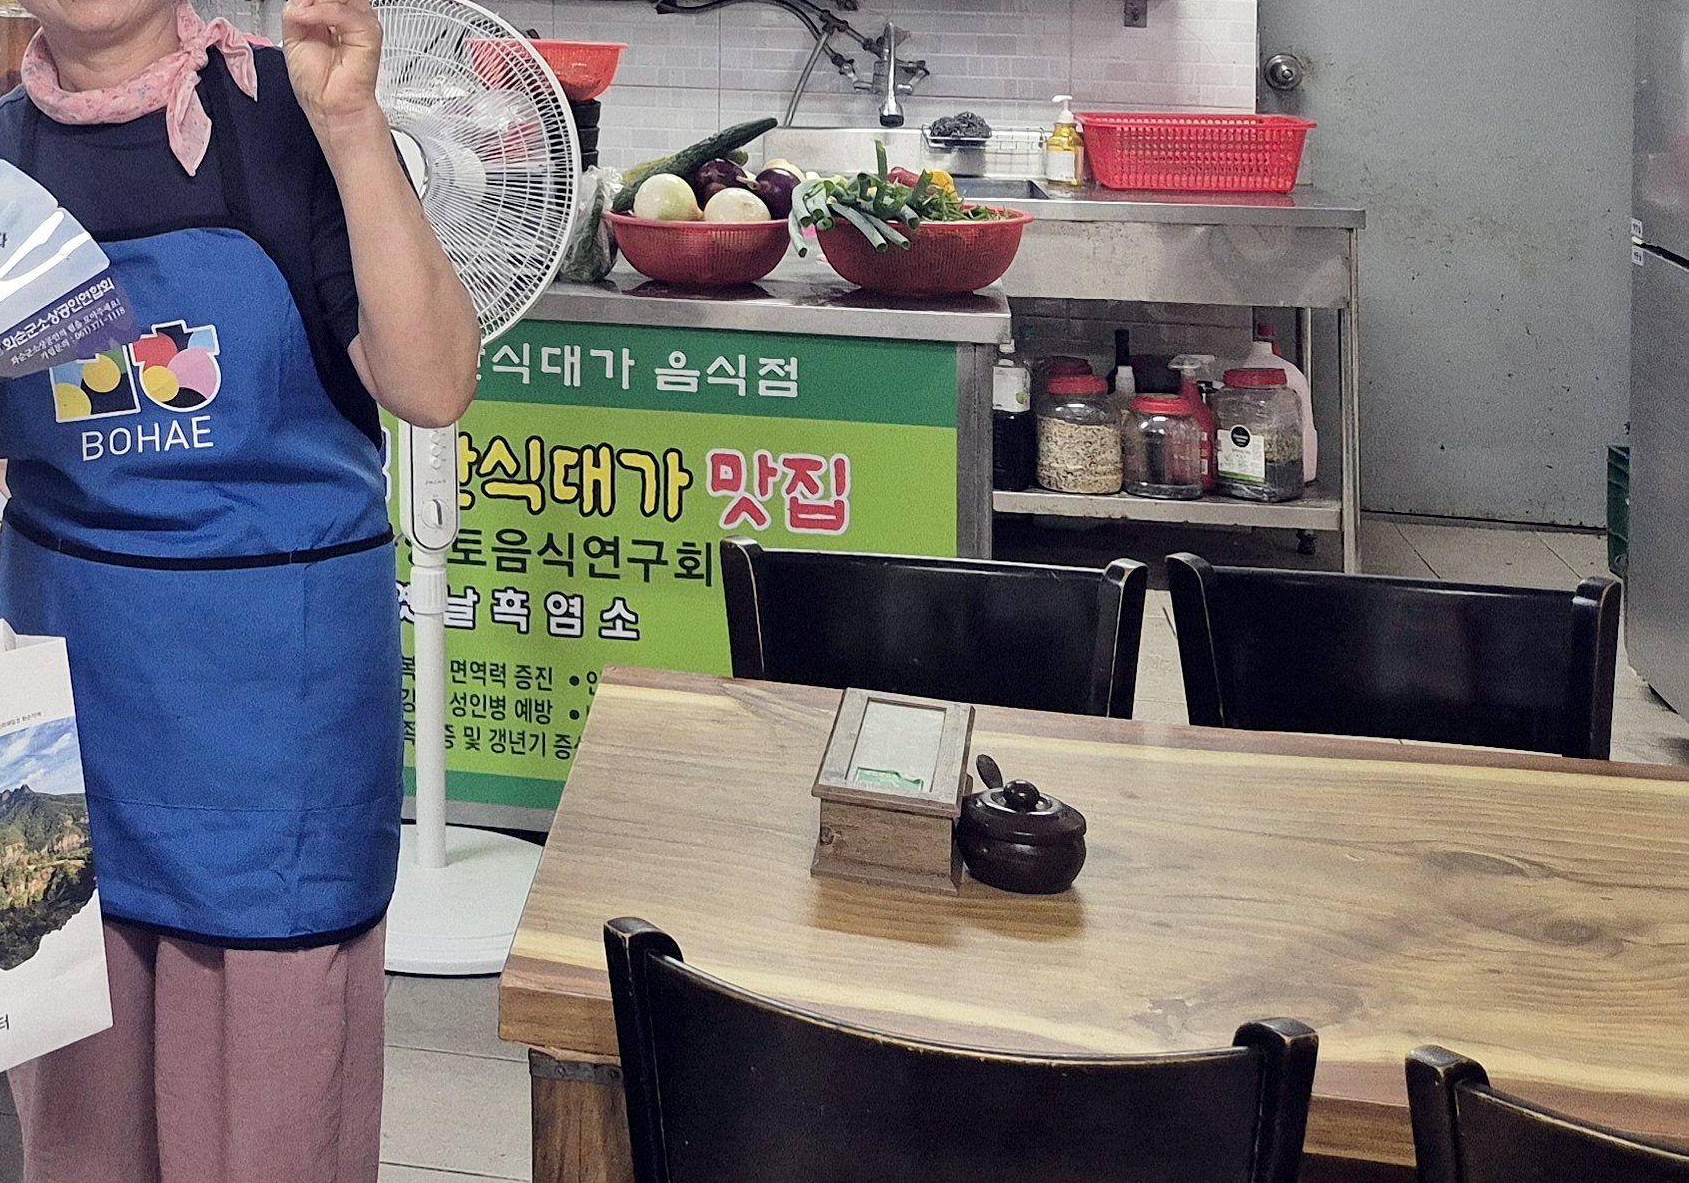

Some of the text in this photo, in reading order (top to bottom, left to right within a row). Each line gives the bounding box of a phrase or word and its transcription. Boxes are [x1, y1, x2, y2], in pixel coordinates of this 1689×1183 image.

[2, 277, 116, 351] 화순군소상공인연합회
[654, 349, 800, 399] 음식점
[81, 415, 215, 461] BOHAE
[704, 447, 852, 536] 맛집
[396, 526, 713, 588] 토음식연구회
[449, 659, 506, 688] 면역력
[513, 664, 553, 692] 증진
[449, 692, 553, 725] 성인병 예방
[463, 725, 481, 752] 및
[488, 728, 547, 758] 갱년기
